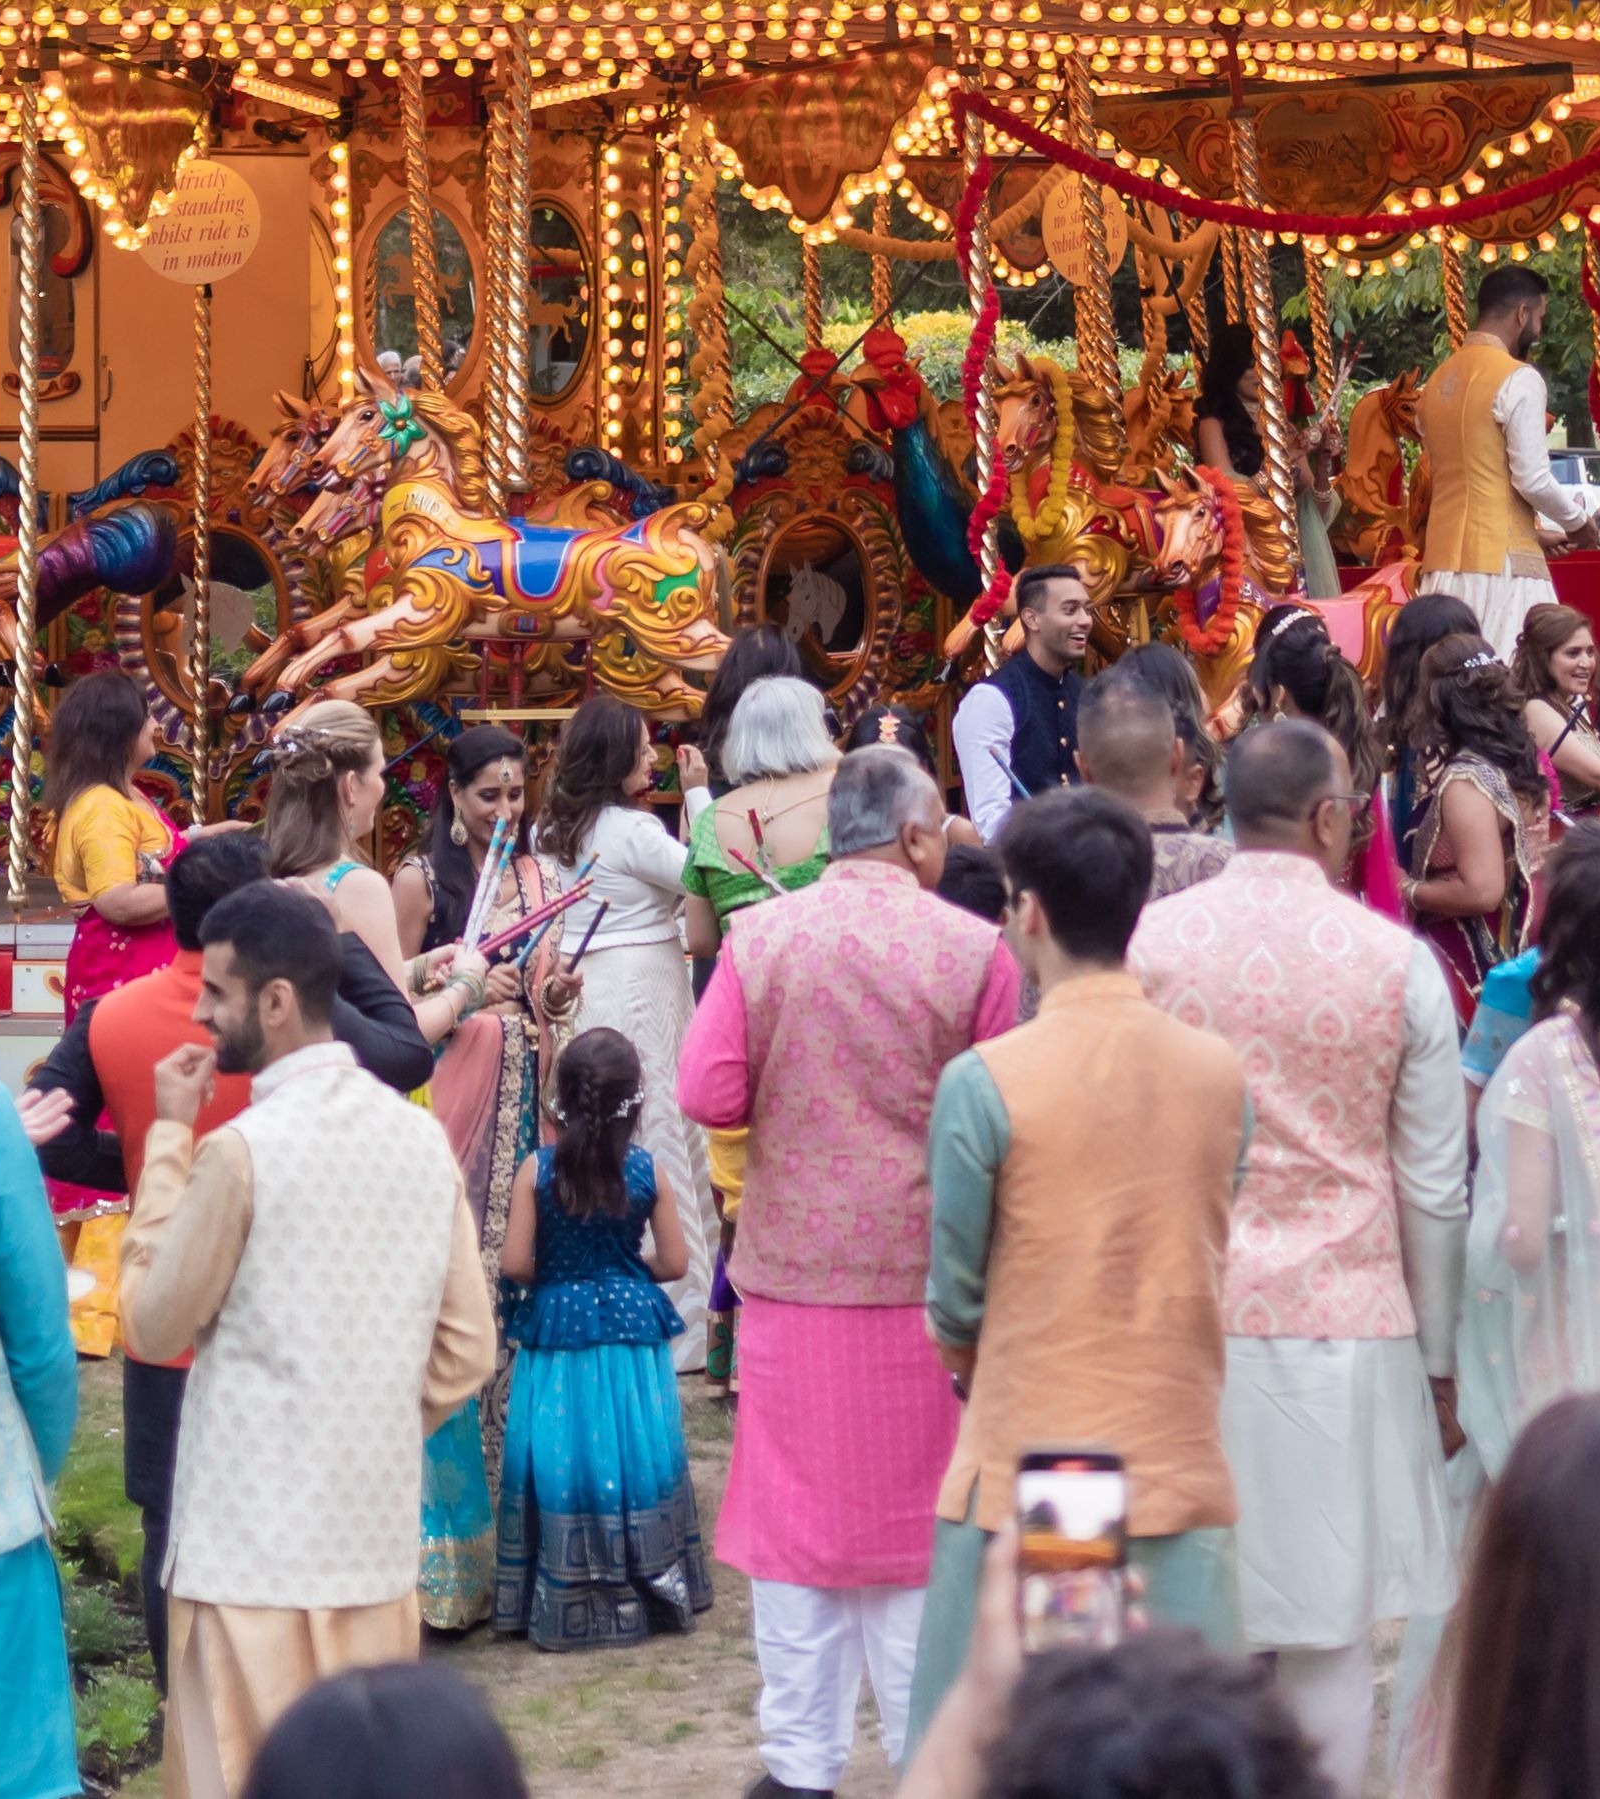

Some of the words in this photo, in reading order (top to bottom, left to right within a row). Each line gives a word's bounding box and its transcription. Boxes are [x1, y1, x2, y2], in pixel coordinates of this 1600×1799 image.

[174, 167, 227, 191] trictly
[176, 193, 246, 217] standing
[199, 220, 231, 242] ride
[237, 218, 250, 239] is
[162, 250, 179, 271] in
[186, 246, 242, 269] motion
